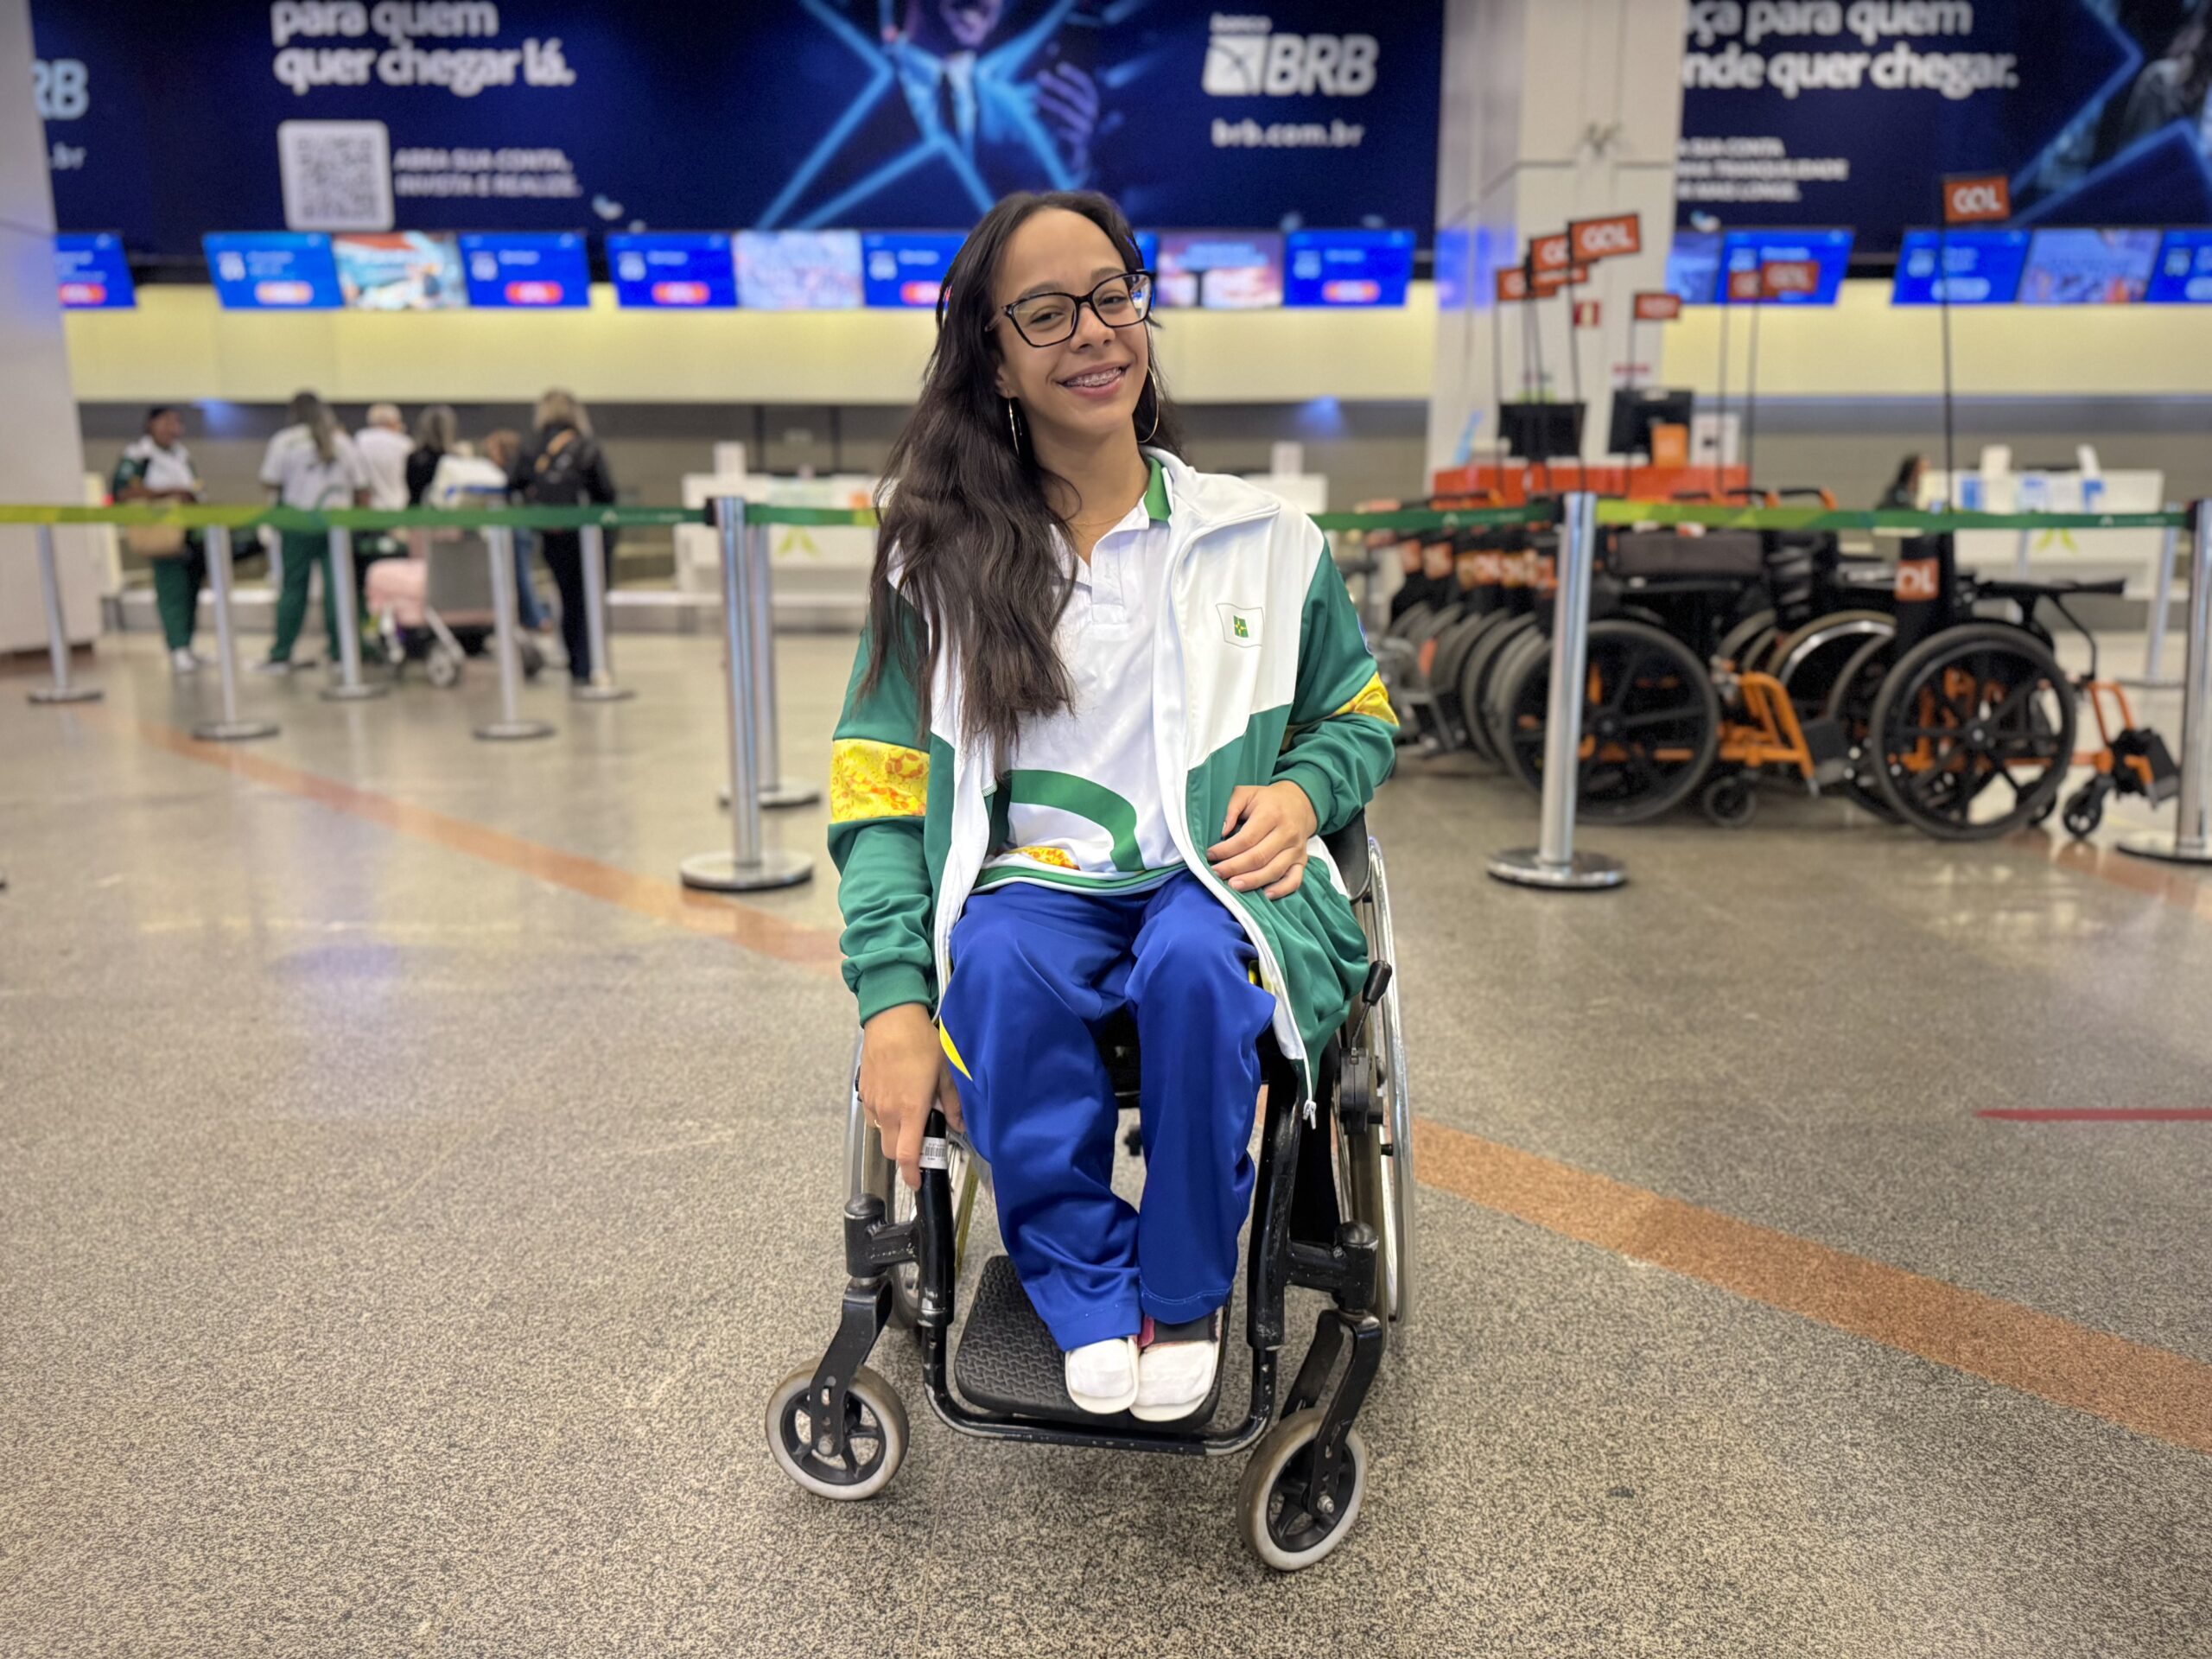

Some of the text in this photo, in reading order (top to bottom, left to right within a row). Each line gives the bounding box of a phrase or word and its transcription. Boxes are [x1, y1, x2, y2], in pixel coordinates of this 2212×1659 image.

[271, 0, 499, 49] para quem
[1745, 0, 1842, 45] para
[1846, 0, 1974, 45] quem
[273, 38, 576, 96] quer chegar lá.
[1264, 33, 1378, 96] BRB
[1767, 52, 1869, 99] quer
[1870, 41, 2018, 99] chegar.
[1211, 118, 1364, 147] brb.com.br
[1953, 185, 2001, 214] GOL
[1581, 223, 1635, 252] GOL
